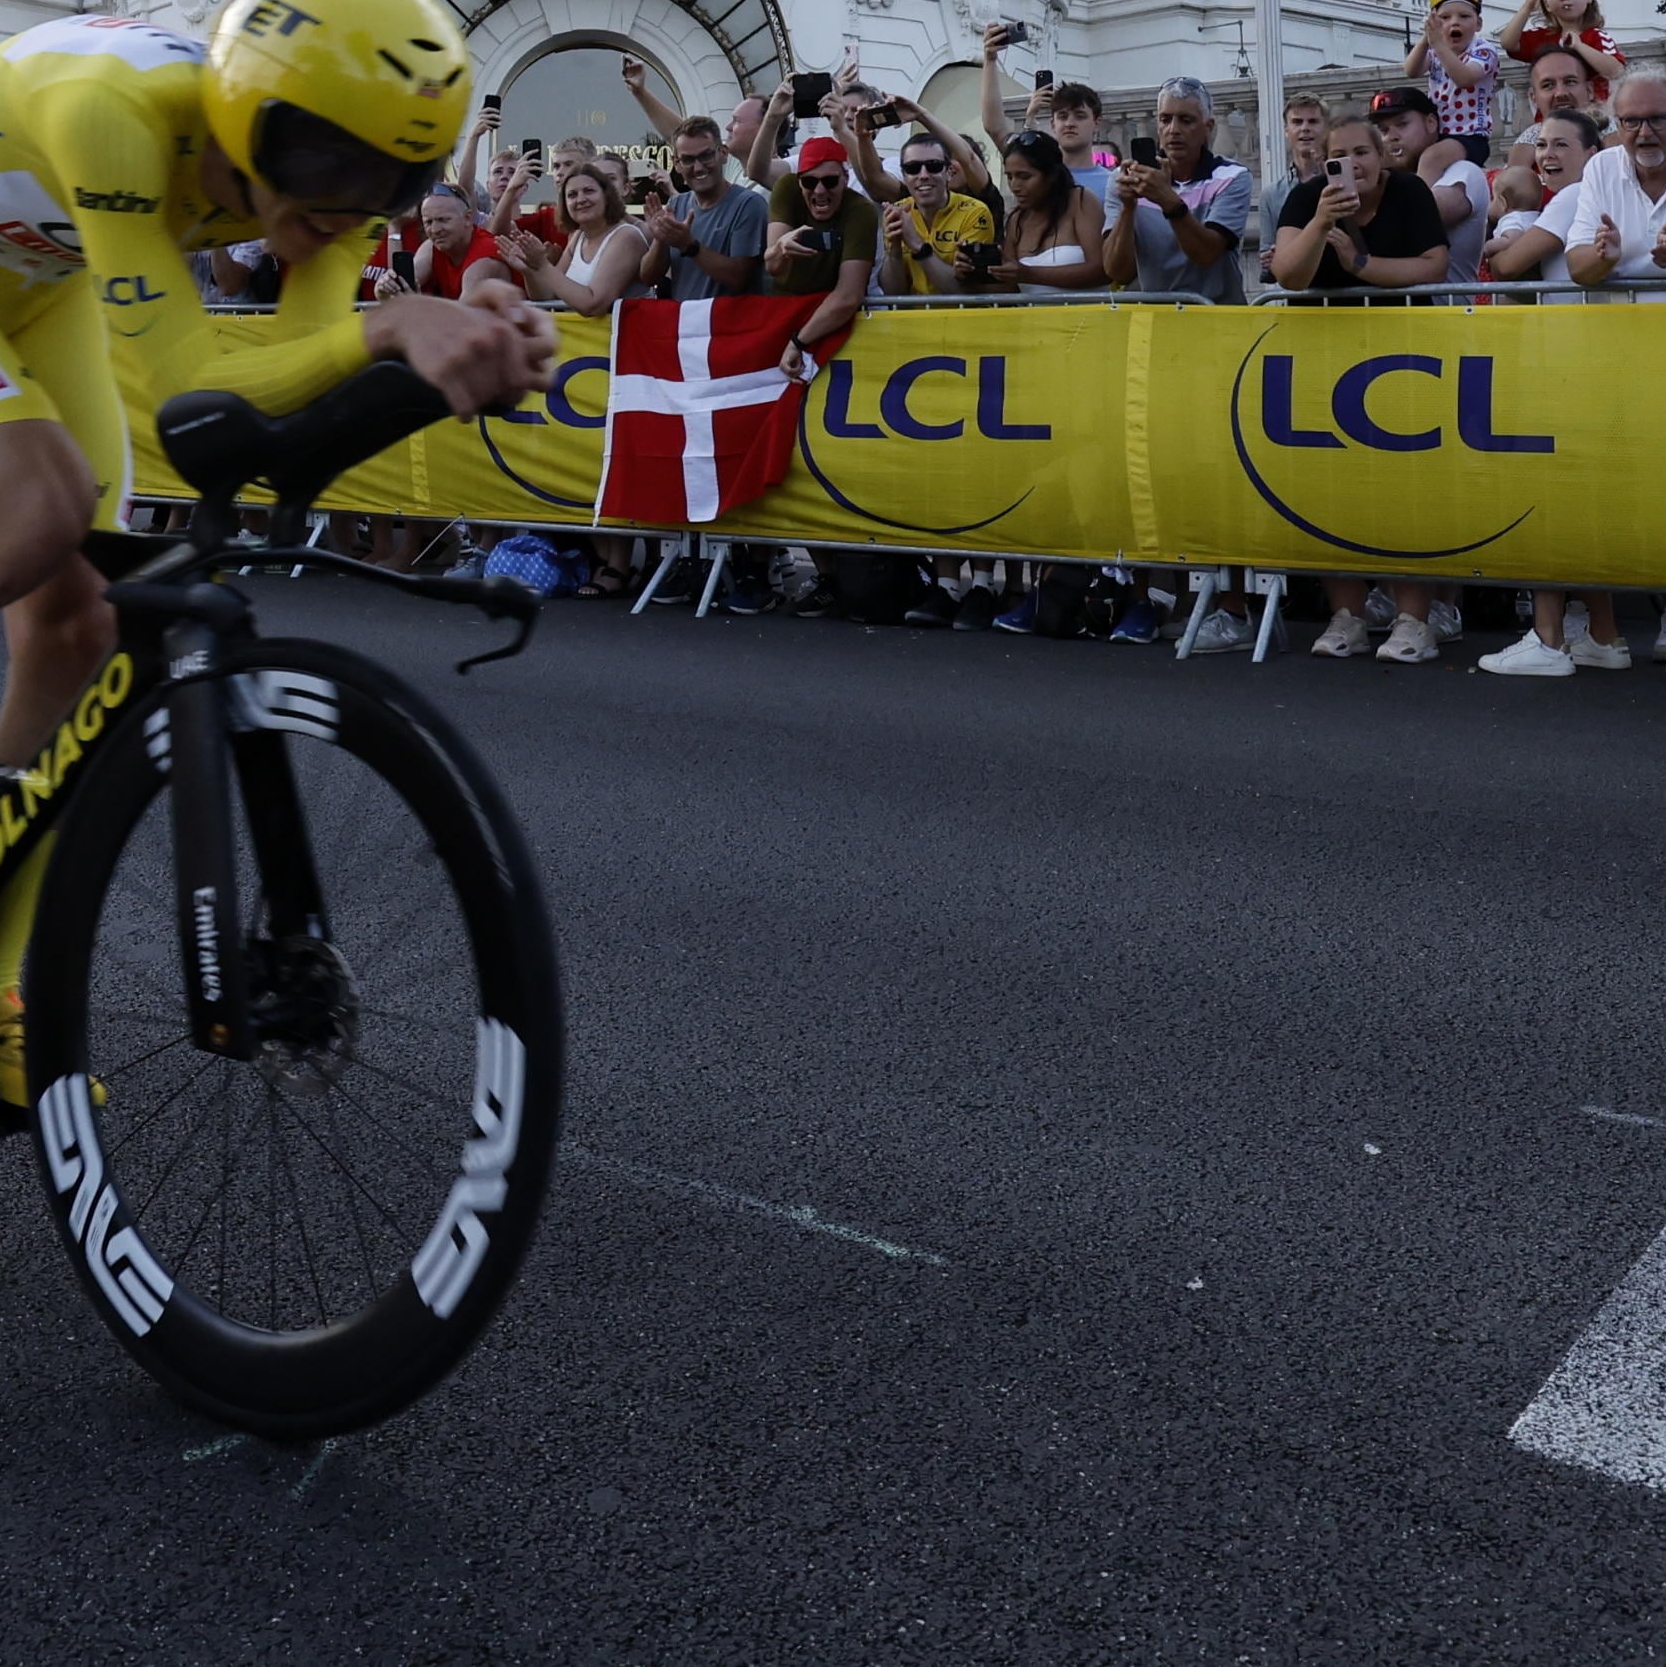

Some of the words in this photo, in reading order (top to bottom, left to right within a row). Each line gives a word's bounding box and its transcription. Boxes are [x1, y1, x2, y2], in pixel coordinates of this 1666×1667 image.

[823, 355, 1053, 441] LCL
[1261, 353, 1556, 454] LCL
[193, 886, 223, 1003] Emirates
